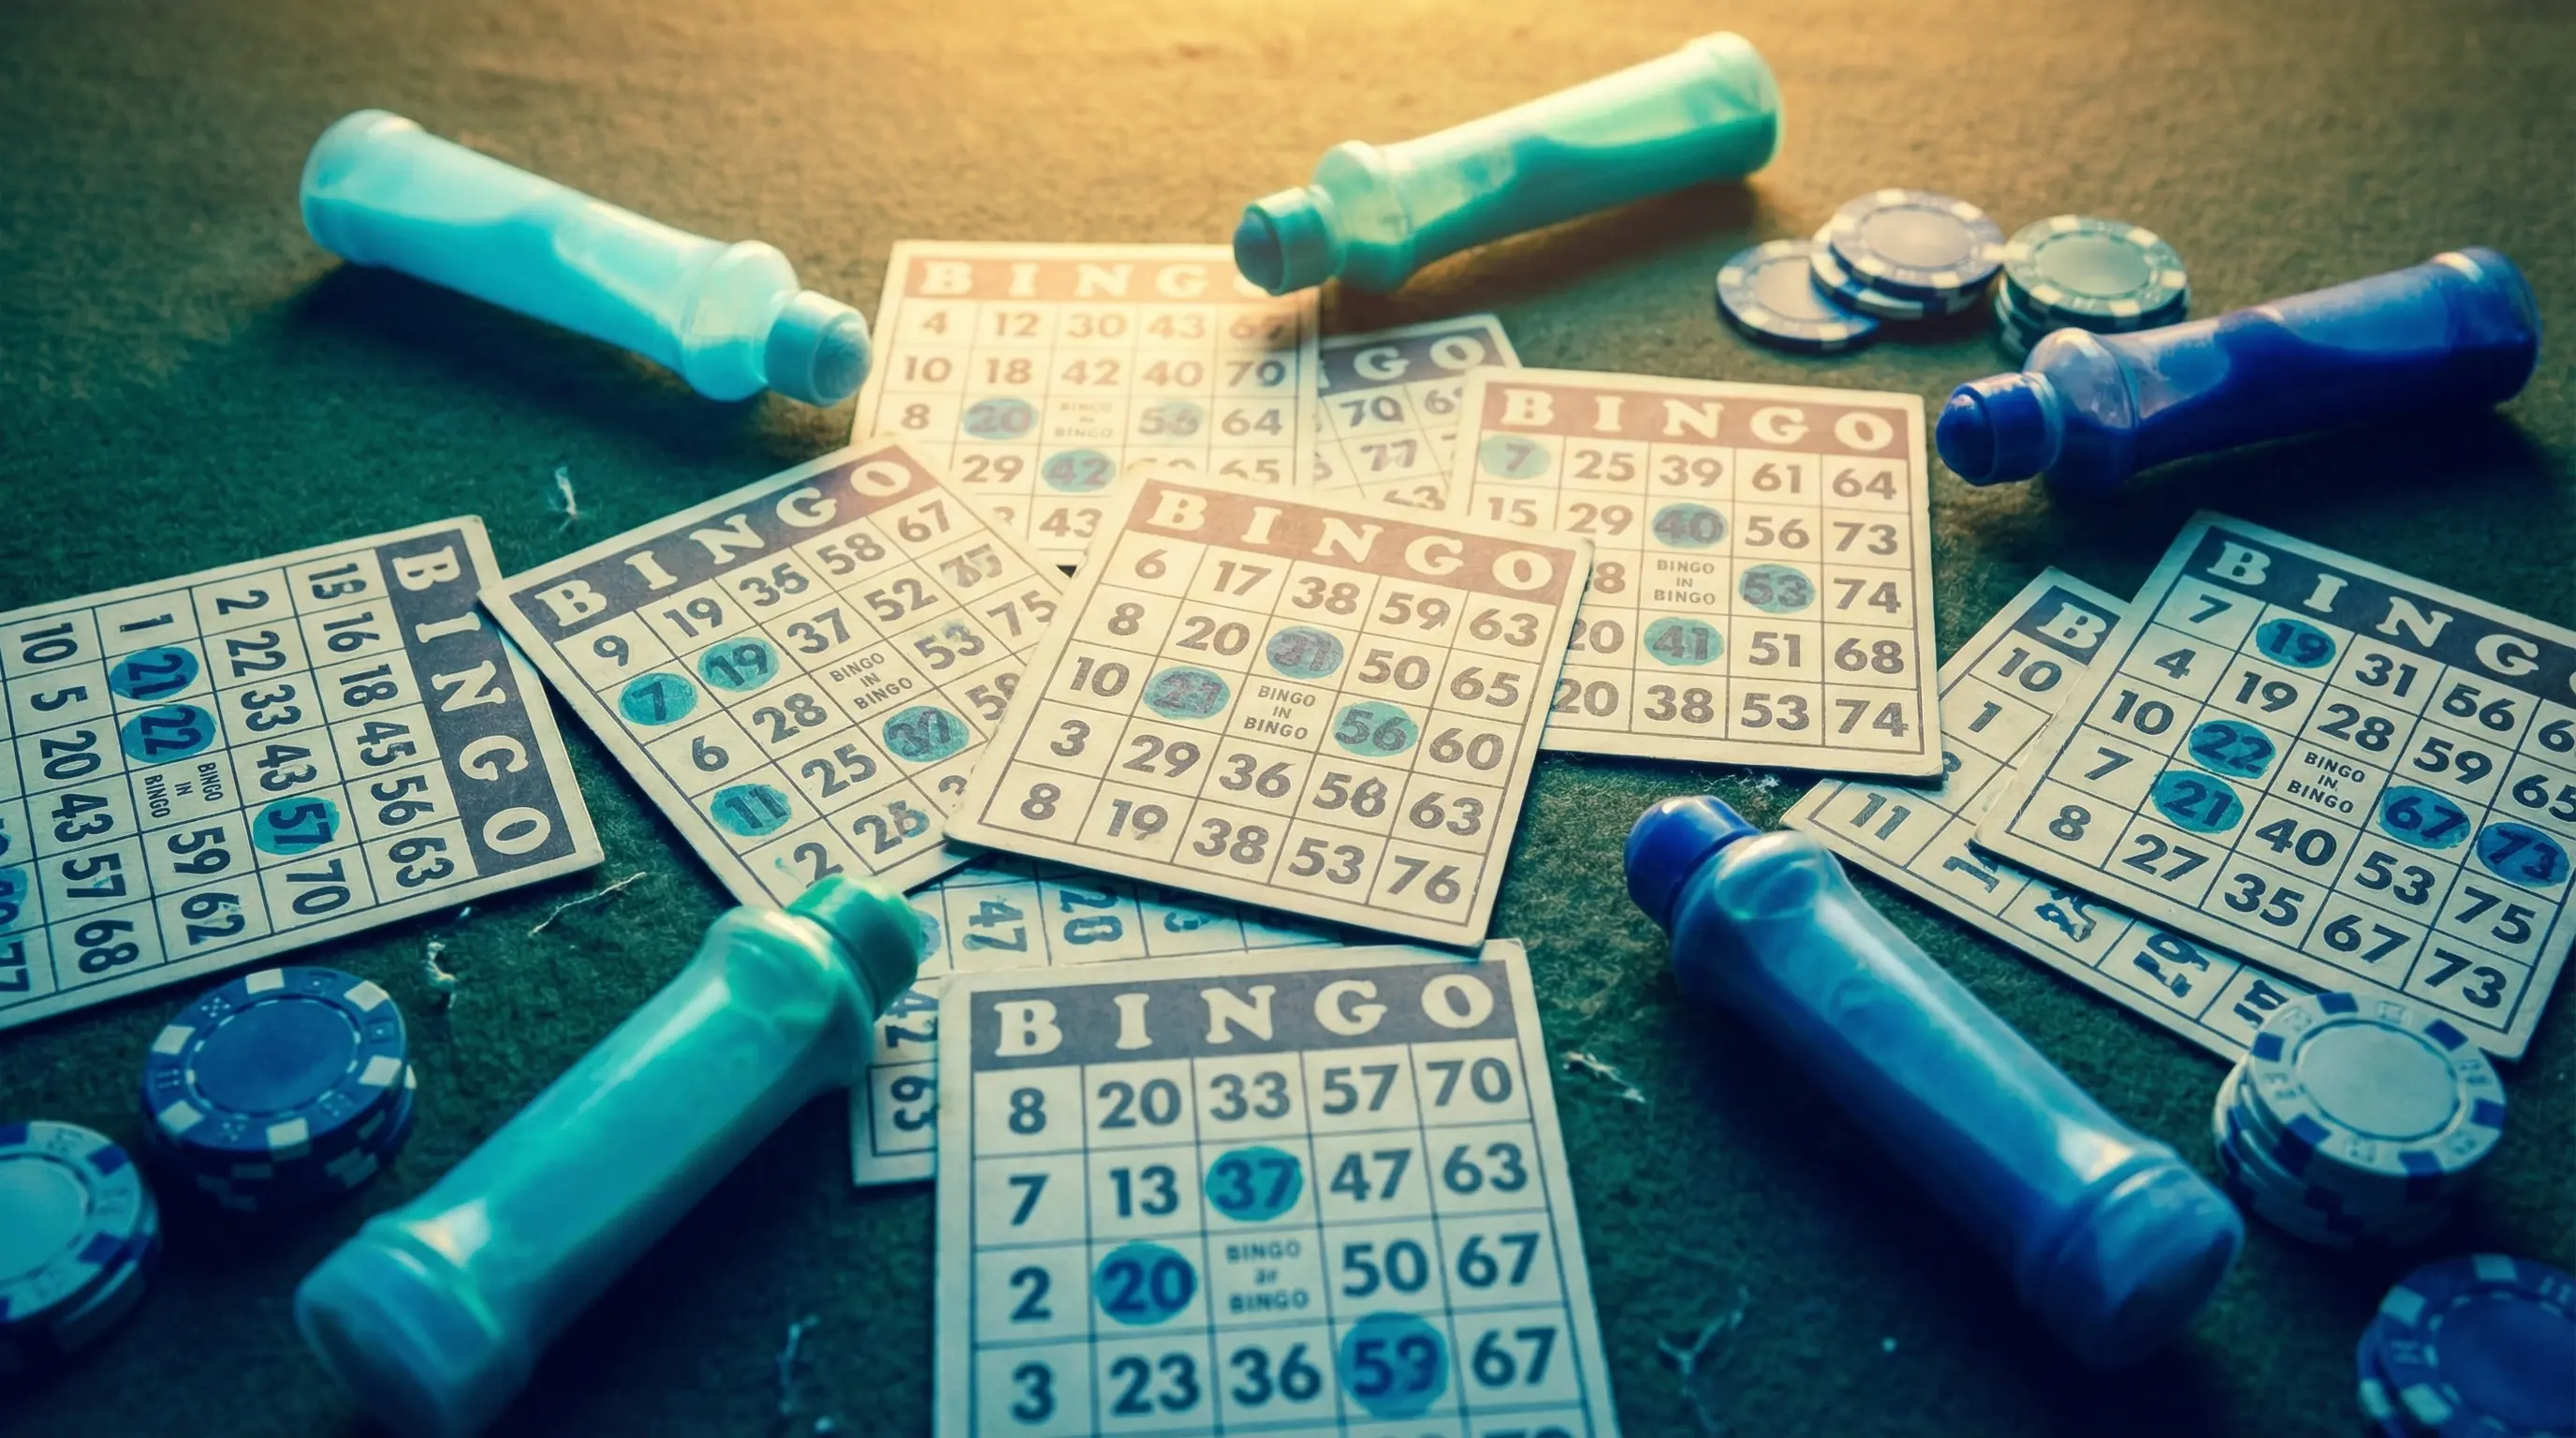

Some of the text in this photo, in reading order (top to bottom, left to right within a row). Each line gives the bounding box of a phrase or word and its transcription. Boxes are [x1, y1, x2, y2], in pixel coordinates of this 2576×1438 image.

[919, 260, 1271, 297] BING
[922, 312, 1205, 338] 4 12 30 43
[905, 356, 952, 383] 10
[987, 359, 1032, 384] 18
[1061, 360, 1120, 386] 42
[1142, 361, 1204, 387] 40
[901, 404, 930, 430] 8
[1222, 409, 1282, 435] 64
[962, 455, 1024, 483] 29
[1573, 450, 1896, 500] 25 39 61 64
[1488, 497, 1897, 555] 15 29 40 56 73
[593, 500, 950, 667] 9 19 58 67
[1657, 560, 1715, 574] BINGO
[1676, 578, 1692, 587] IN
[1134, 550, 1539, 647] 6 17 38 59 63
[1654, 589, 1716, 605] BINGO
[1834, 578, 1901, 613] 74
[2206, 542, 2575, 697] BING
[632, 578, 939, 721] 7 19 37 52
[829, 653, 885, 685] BINGO
[914, 624, 985, 669] 53
[1107, 603, 1145, 636] 8
[1176, 616, 1250, 655] 20
[1358, 649, 1430, 690] 50
[1450, 667, 1520, 707] 65
[1652, 625, 1904, 674] 41 51 68
[1998, 648, 2062, 692] 10
[2188, 594, 2514, 731] 7 19 31 56
[119, 613, 200, 756] 1 21 22
[854, 672, 913, 710] BINGO
[860, 672, 881, 687] IN
[1070, 656, 1130, 697] 10
[1258, 685, 1316, 707] BINGO
[692, 693, 827, 771] 6 28
[1244, 716, 1308, 740] BINGO
[1273, 706, 1292, 719] IN
[1552, 679, 1909, 737] 20 38 53 74
[2112, 690, 2265, 773] 10 22
[2154, 649, 2493, 785] 4 19 28 59
[215, 590, 350, 915] 2 22 33 57 70
[323, 611, 454, 888] 16 18 45 56 63
[1334, 707, 1503, 770] 56 60
[175, 782, 193, 796] IN
[198, 762, 224, 801] BINGO
[724, 743, 876, 830] 11 25
[1050, 720, 1484, 836] 3 29 36 63
[2305, 752, 2365, 785] BINGO
[21, 623, 139, 974] 10 5 20 43 57 68
[144, 774, 170, 818] BINGO
[1850, 793, 1910, 841] 11
[2287, 776, 2353, 814] BINGO
[2386, 796, 2466, 840] 67
[1020, 783, 1460, 904] 8 19 38 53 76
[2084, 747, 2536, 944] 7 21 40 53 75
[168, 827, 245, 946] 59 62
[2049, 805, 2507, 1008] 8 27 35 67 73
[1008, 1058, 1513, 1135] 8 20 33 57 70
[1008, 1142, 1528, 1226] 7 13 37 47 63
[1225, 1240, 1301, 1263] BINGO
[1342, 1232, 1540, 1298] 50 67
[1009, 1257, 1193, 1323] 2 20
[1229, 1288, 1310, 1313] BINGO
[1010, 1327, 1557, 1425] 3 23 36 67
